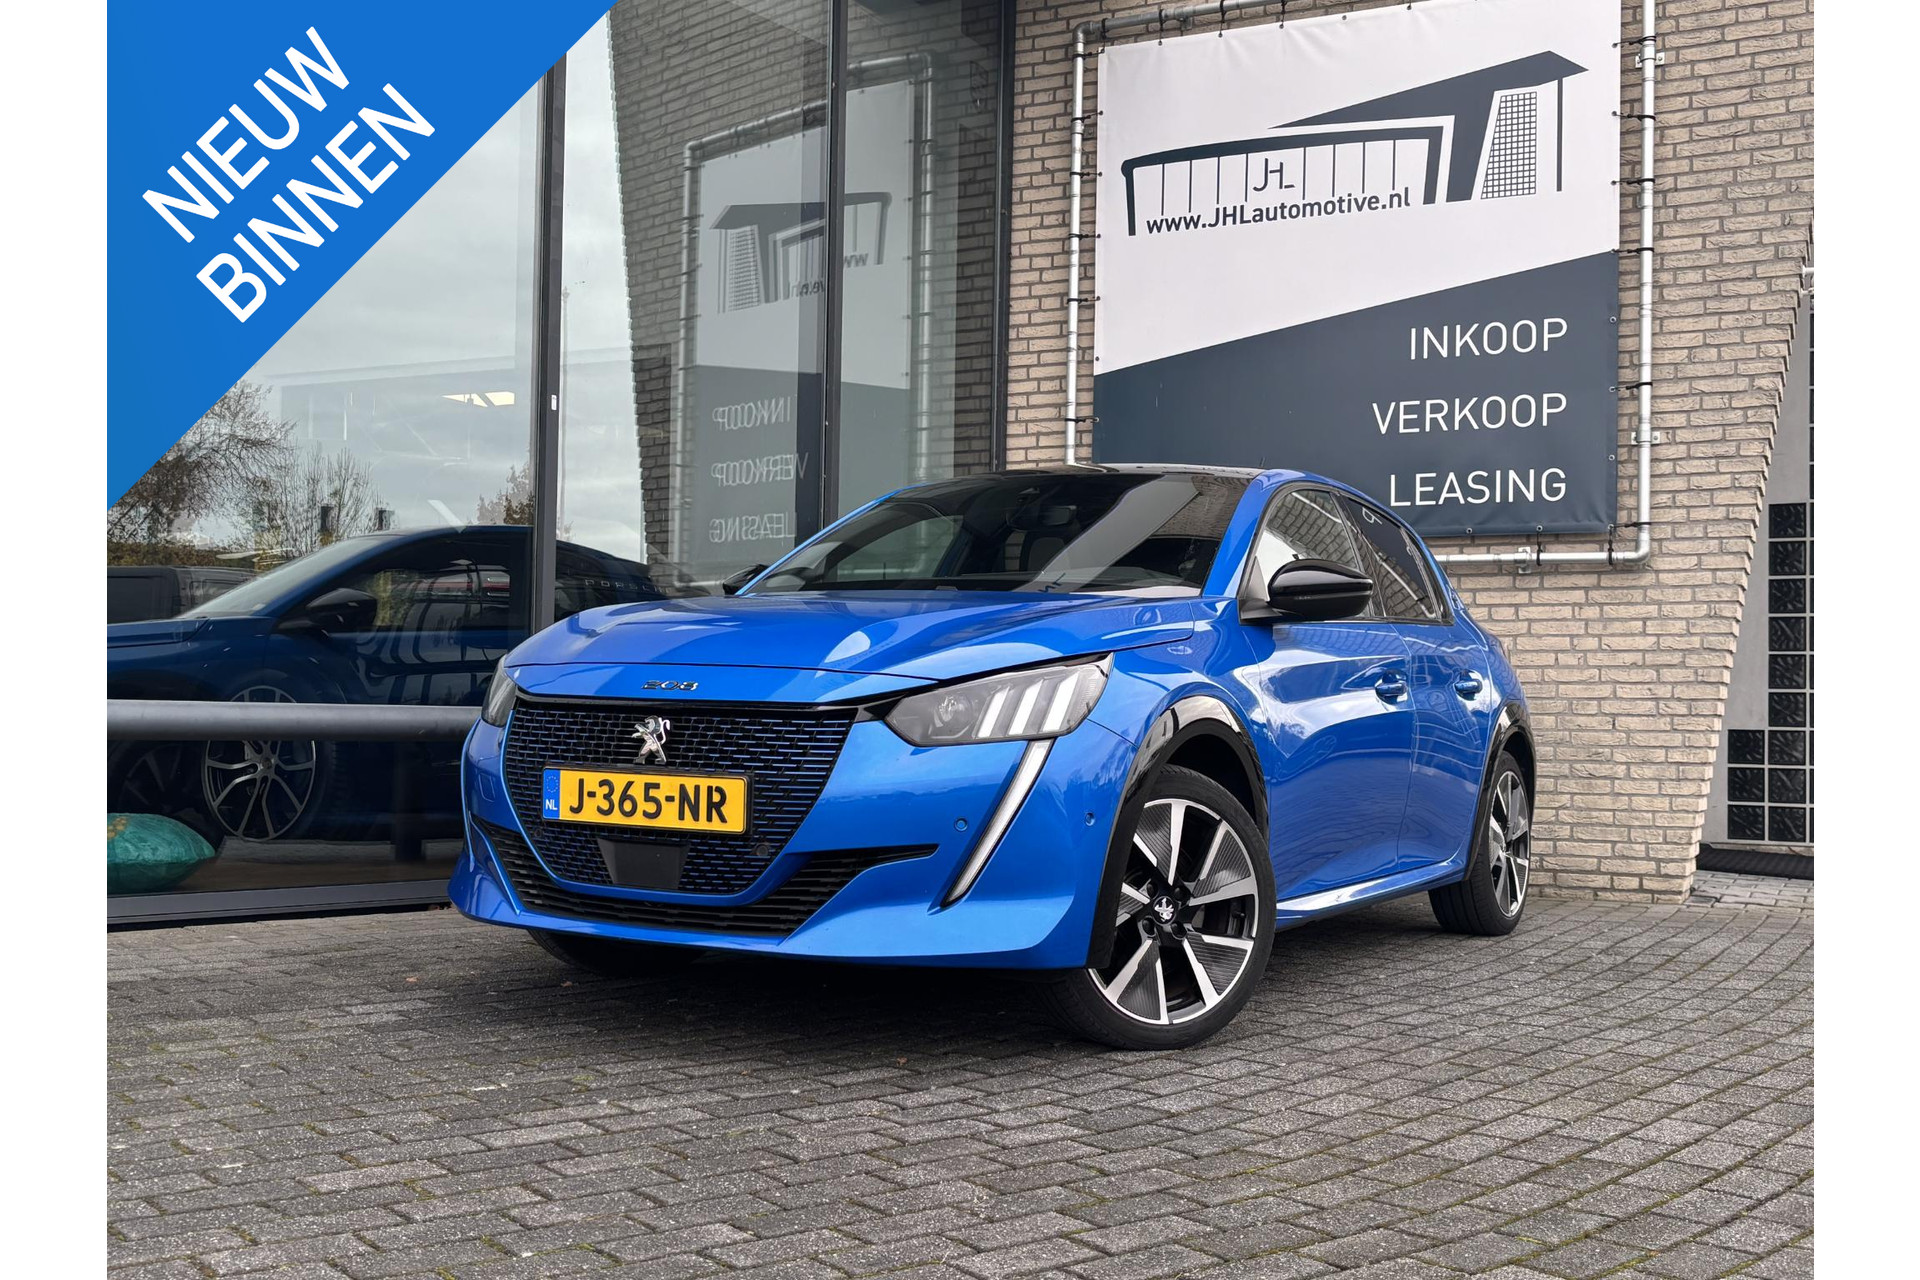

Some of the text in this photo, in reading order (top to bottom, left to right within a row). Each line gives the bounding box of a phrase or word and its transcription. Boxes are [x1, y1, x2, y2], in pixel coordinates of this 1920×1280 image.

[1146, 186, 1411, 234] www.JHLautomotive.nl
[1410, 317, 1568, 360] INKOOP
[1372, 393, 1567, 435] VERKOOP
[1390, 467, 1567, 507] LEASING
[640, 679, 699, 692] 208
[545, 798, 558, 812] NL
[569, 777, 728, 824] J-365-NR
